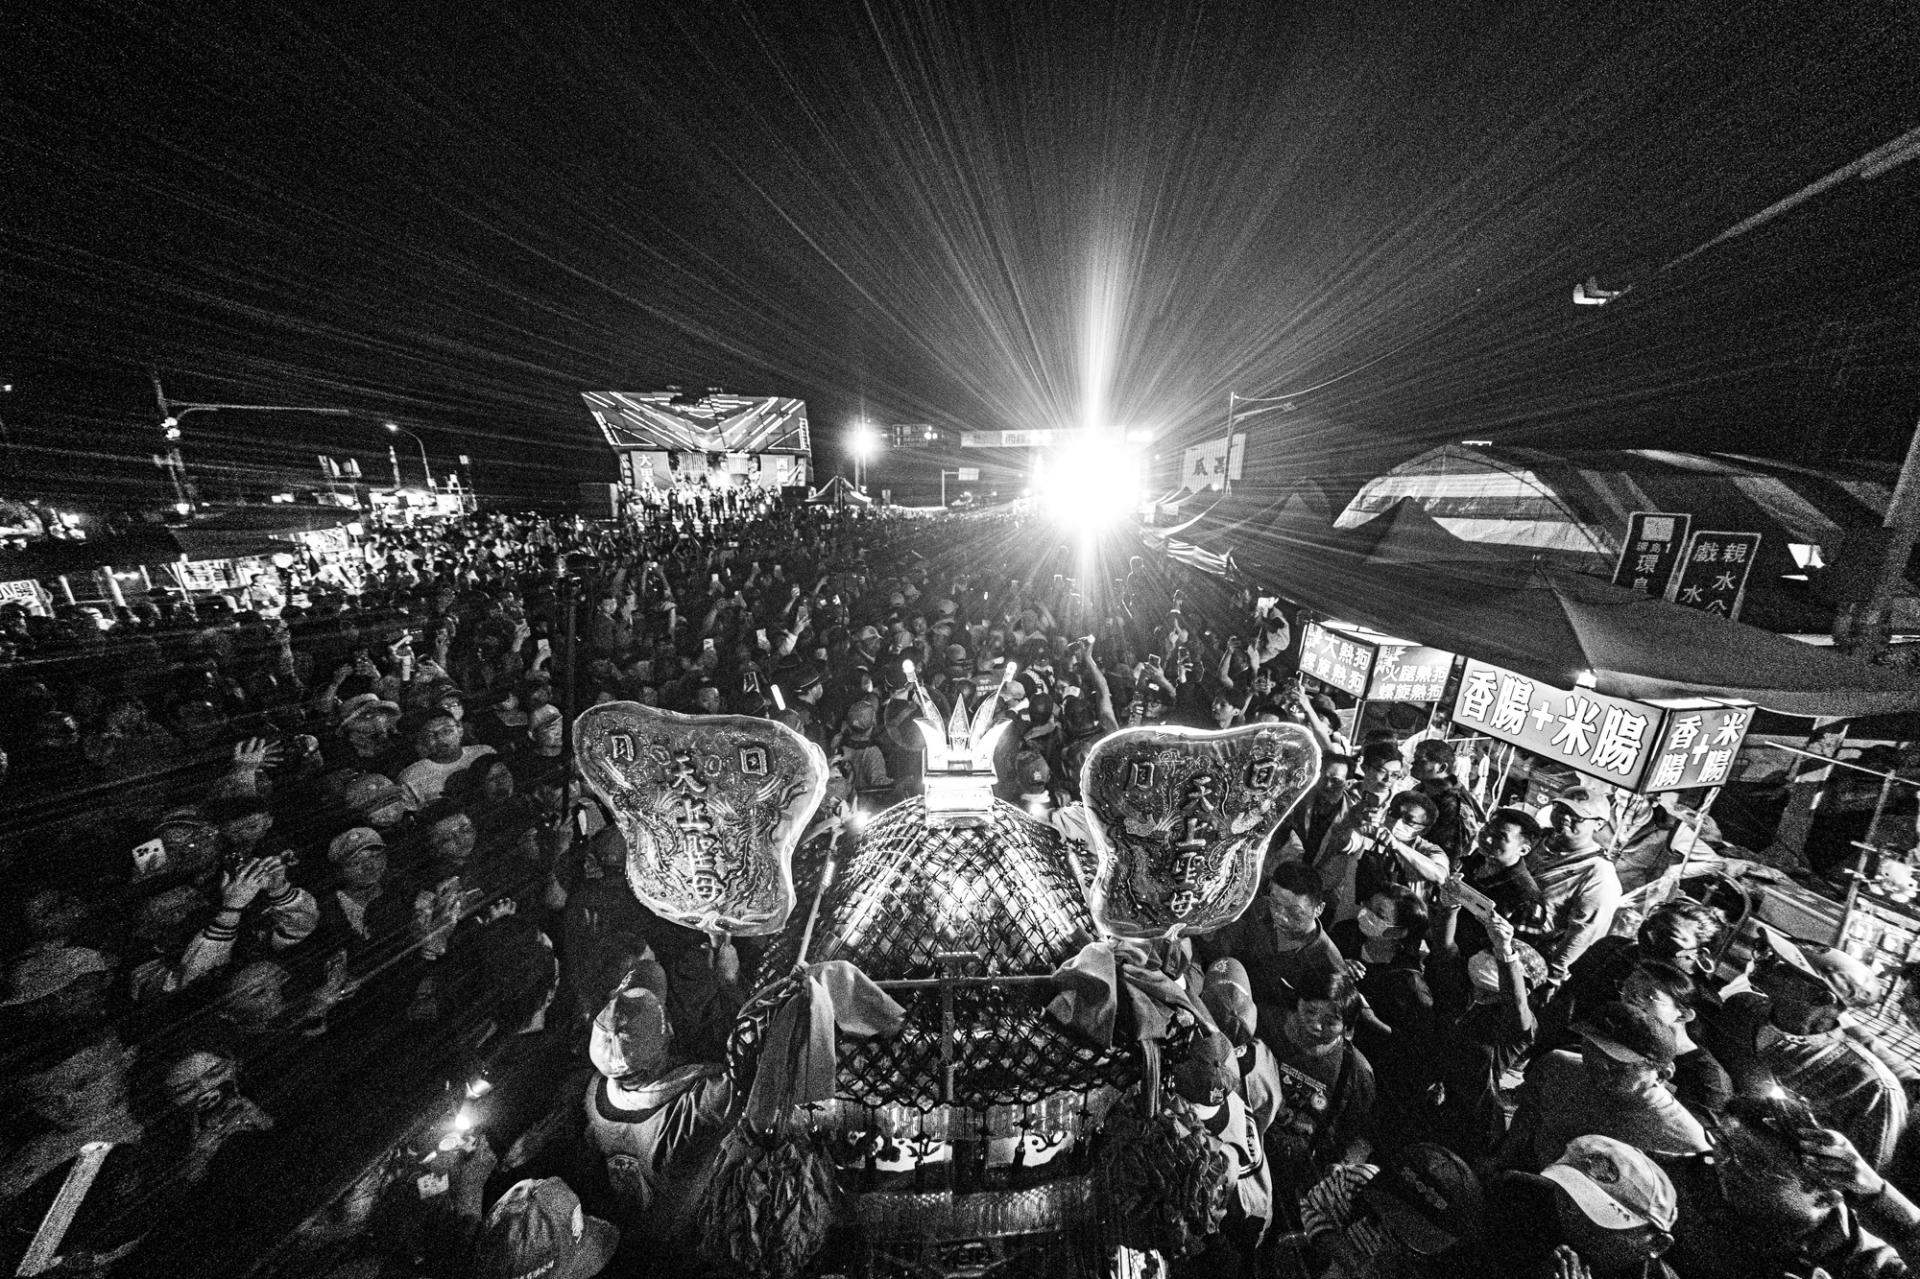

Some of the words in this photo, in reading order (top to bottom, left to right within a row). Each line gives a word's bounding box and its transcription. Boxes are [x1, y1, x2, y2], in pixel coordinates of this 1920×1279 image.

[1381, 664, 1449, 683] 火腿熱狗
[1379, 683, 1444, 700] 螺旋熱狗
